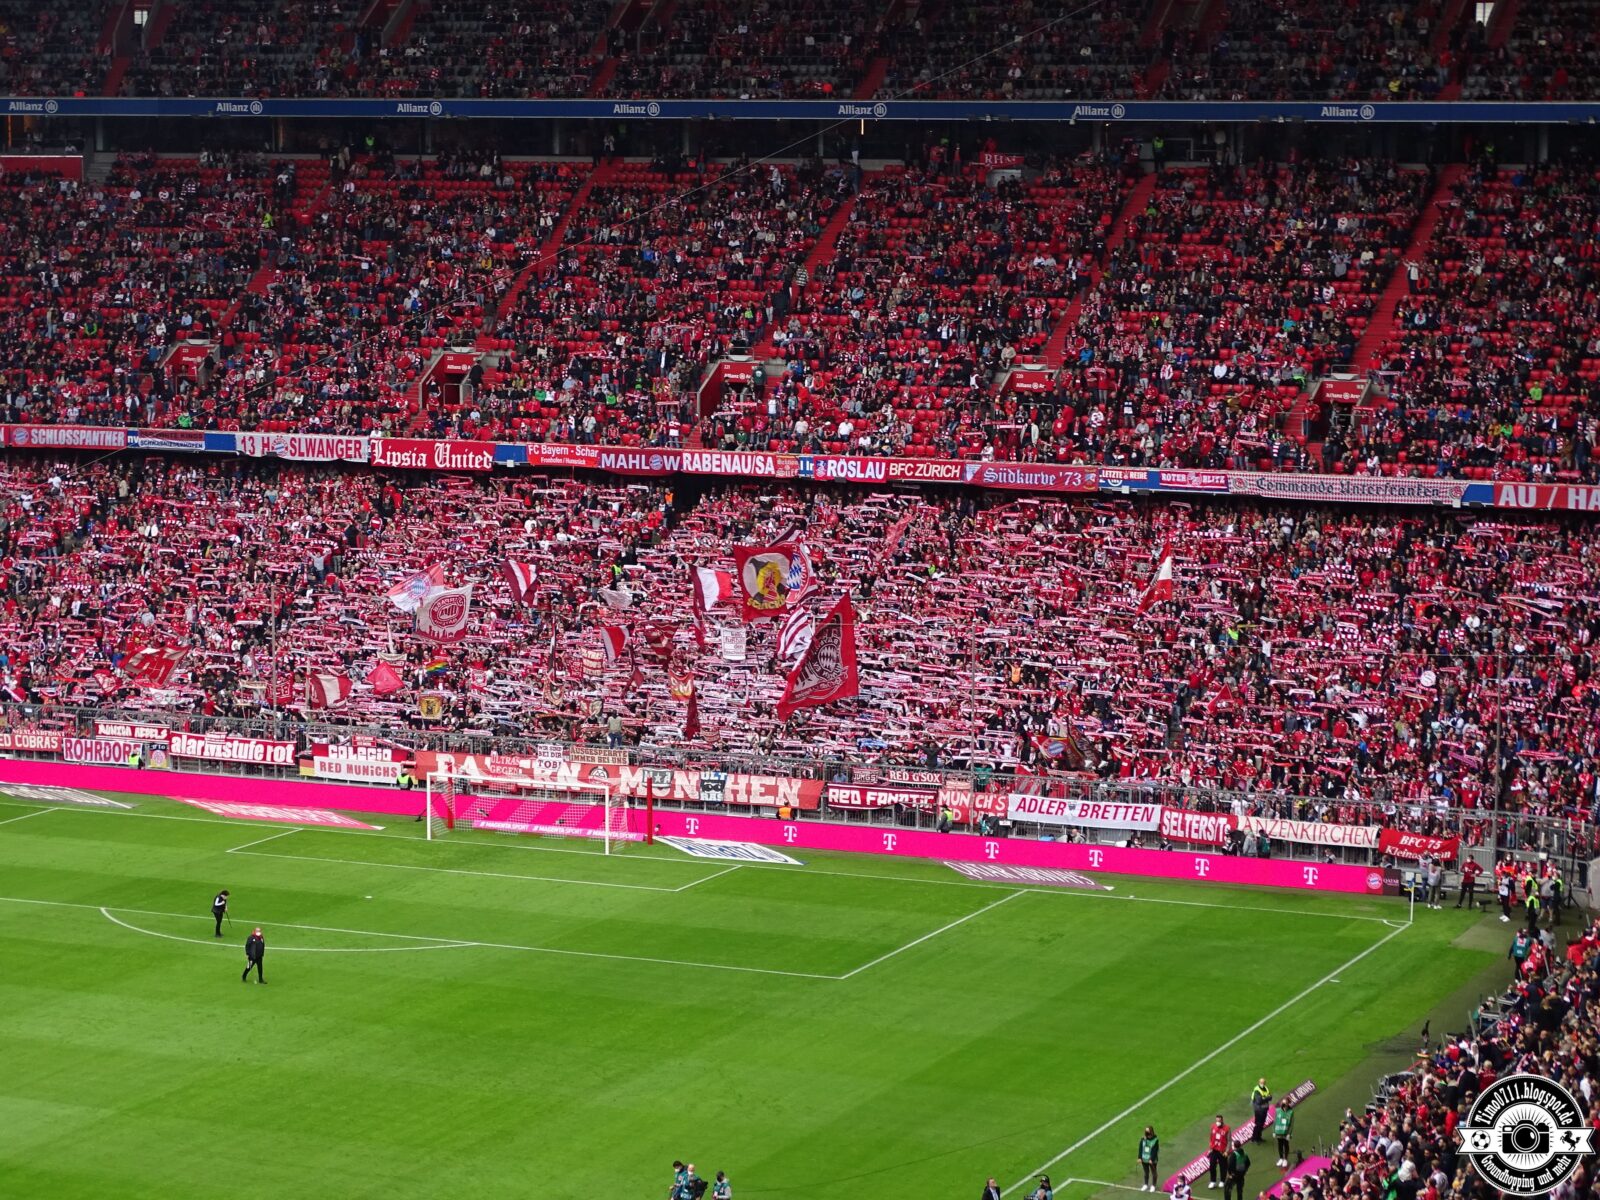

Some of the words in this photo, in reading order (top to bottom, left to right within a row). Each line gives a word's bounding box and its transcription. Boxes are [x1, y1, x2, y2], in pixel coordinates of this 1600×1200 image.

[9, 101, 43, 111] Allianz
[217, 102, 248, 112] Allianz
[397, 103, 428, 113] Allianz
[614, 104, 646, 114] Allianz
[839, 104, 872, 115] Allianz
[1074, 105, 1109, 116] Allianz
[1321, 106, 1358, 117] Allianz
[31, 428, 125, 446] SCHLOSSPANTHER
[241, 435, 256, 455] 13
[528, 445, 539, 455] FC
[541, 445, 569, 457] Bayern
[575, 446, 599, 457] Schar
[370, 440, 427, 467] Lipsia
[434, 443, 494, 469] United
[682, 452, 776, 475] RABENAU/SA
[827, 458, 886, 480] RÖSLAU
[889, 463, 914, 476] BFC
[915, 463, 960, 478] ZÜRICH
[983, 467, 1056, 487] Südkurve
[1059, 472, 1082, 487] '73
[1102, 470, 1123, 479] LETZTE
[1161, 472, 1187, 482] ROTER
[1256, 478, 1333, 494] Commando
[1339, 481, 1440, 499] Unterfranken
[1498, 485, 1537, 508] AU
[14, 734, 59, 750] COBRAS
[265, 743, 295, 765] rot
[570, 754, 597, 763] IMMER
[571, 747, 628, 758] AUSGESPERRTE
[320, 760, 342, 773] RED
[490, 764, 519, 775] GEGEN
[889, 769, 910, 780] RED
[617, 765, 802, 808] MNHEN
[937, 789, 1007, 812] MUNCH'S
[1015, 797, 1067, 816] ADLER
[1078, 803, 1155, 823] BRETTEN
[1399, 835, 1426, 849] BFC
[1427, 839, 1443, 850] 75
